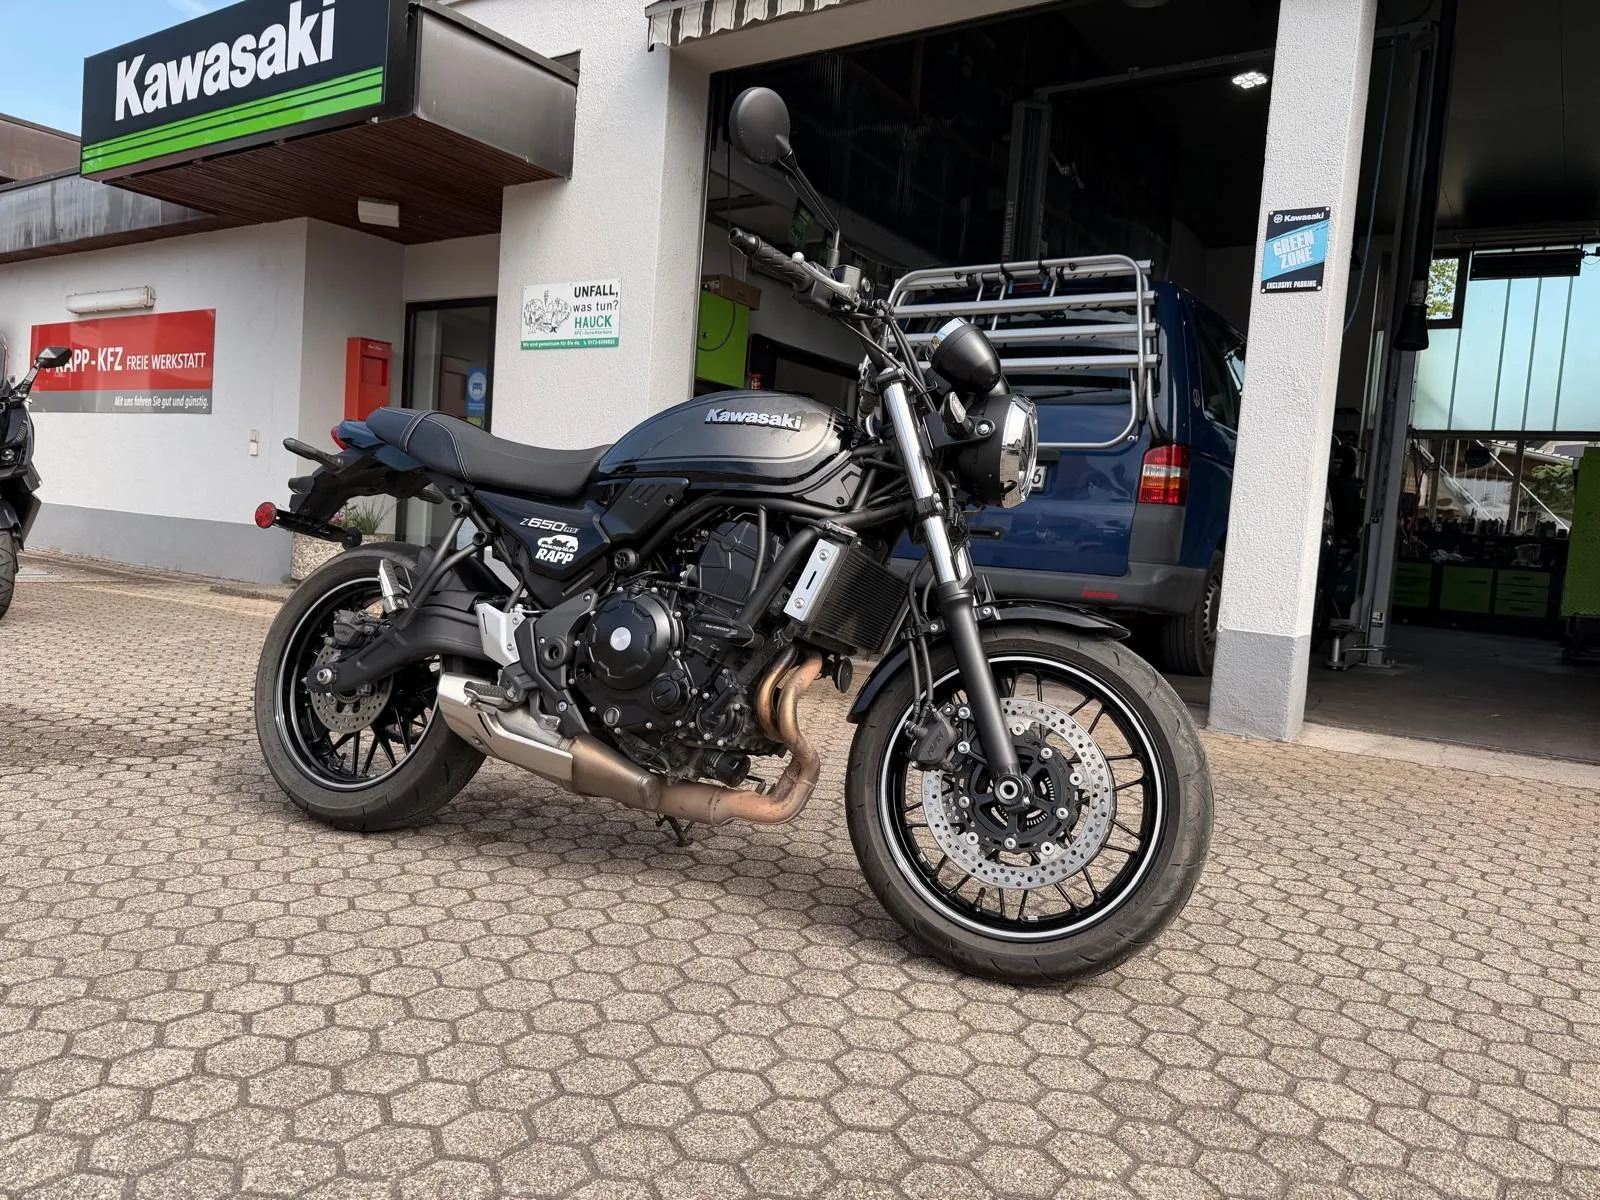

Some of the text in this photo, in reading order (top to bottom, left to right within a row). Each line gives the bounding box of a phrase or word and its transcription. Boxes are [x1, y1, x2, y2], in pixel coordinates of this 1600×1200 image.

[114, 0, 336, 122] Kawasaki
[1283, 212, 1325, 222] Kawasaki
[1273, 230, 1315, 256] GREEN
[1279, 247, 1314, 270] ZONE
[574, 284, 619, 298] UNFALL,
[1266, 280, 1317, 289] EXCLUSIVE PARKING
[573, 300, 619, 312] was tun?
[574, 315, 612, 328] HAUCK
[126, 356, 149, 370] FREIE
[151, 352, 207, 370] WERKSTATT
[114, 395, 209, 408] Mit uns fahren Sie gut und günstig.
[705, 408, 802, 431] Kawasaki
[535, 548, 574, 564] RAPP
